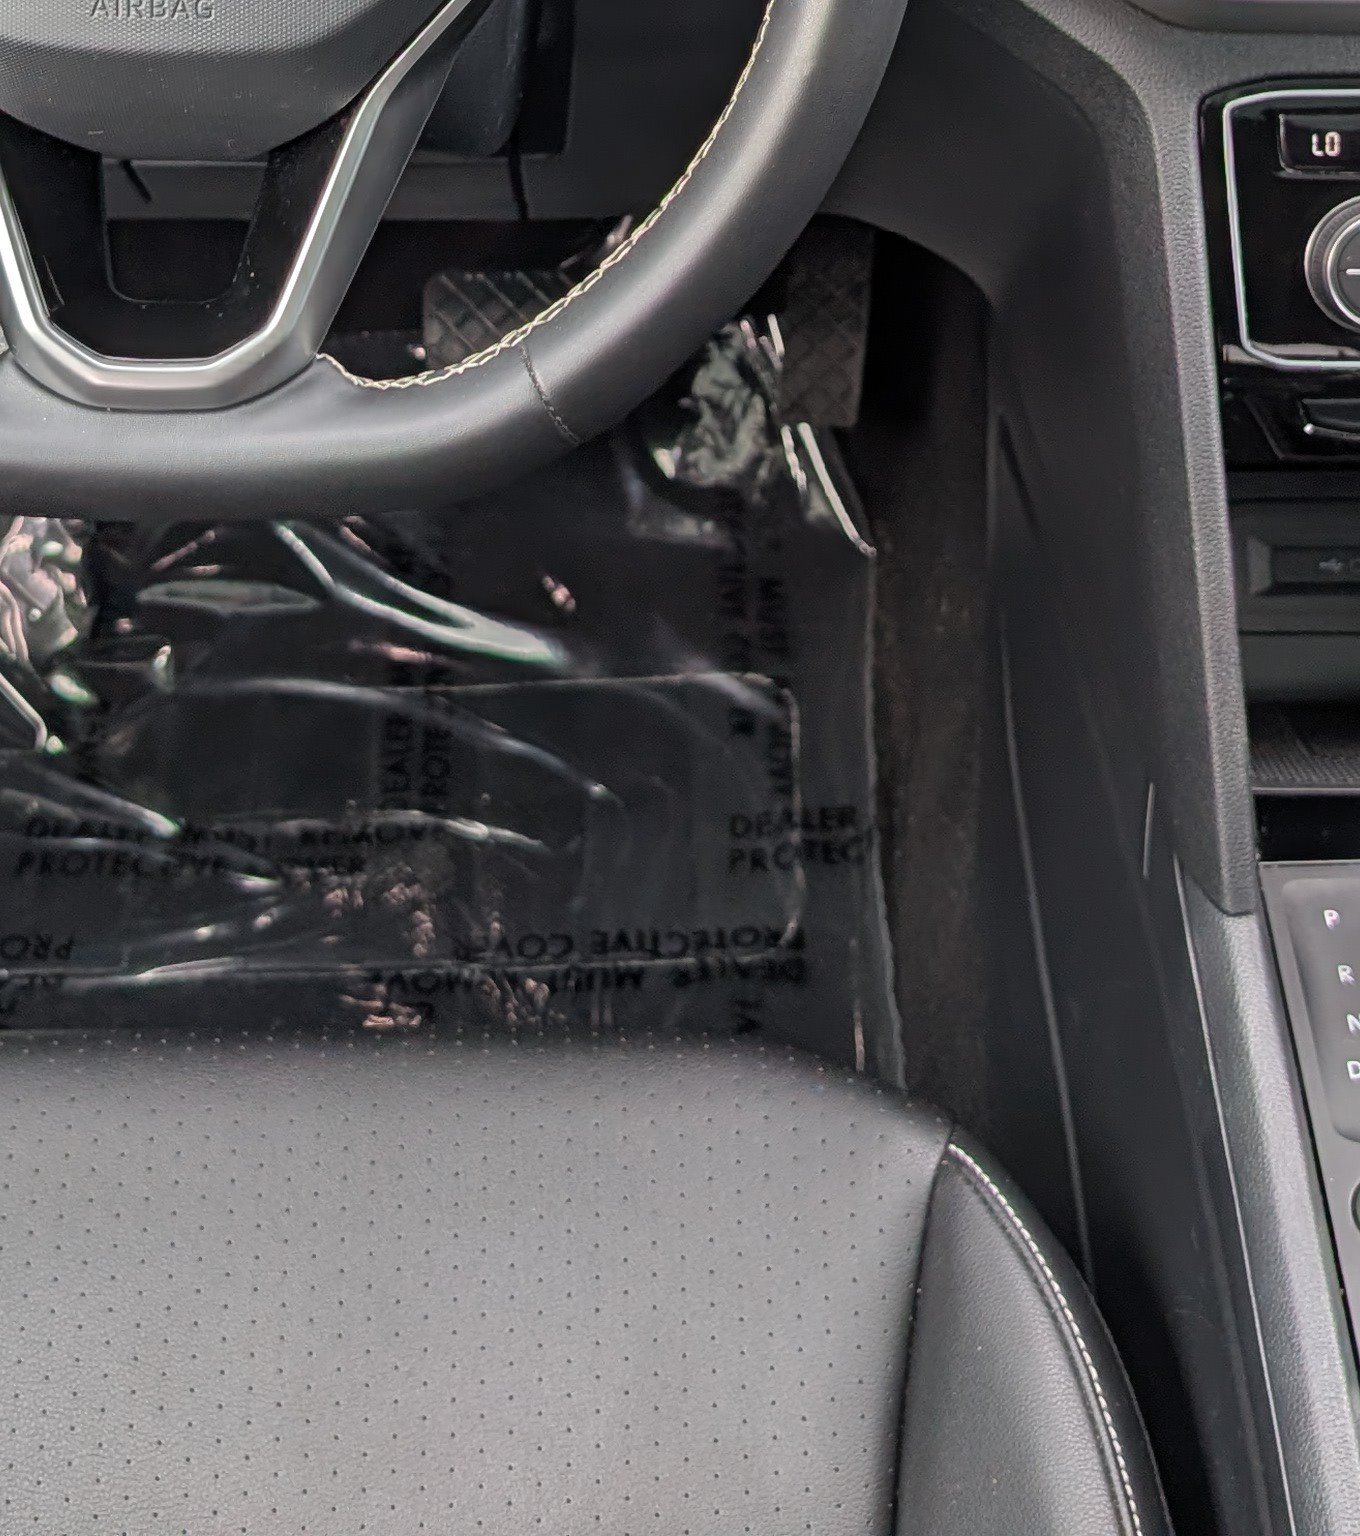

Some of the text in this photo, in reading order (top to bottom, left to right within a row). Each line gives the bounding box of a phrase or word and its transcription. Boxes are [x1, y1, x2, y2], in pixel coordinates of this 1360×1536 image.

[727, 837, 868, 874] PROTEC
[1323, 908, 1340, 931] P
[1337, 964, 1356, 986] R
